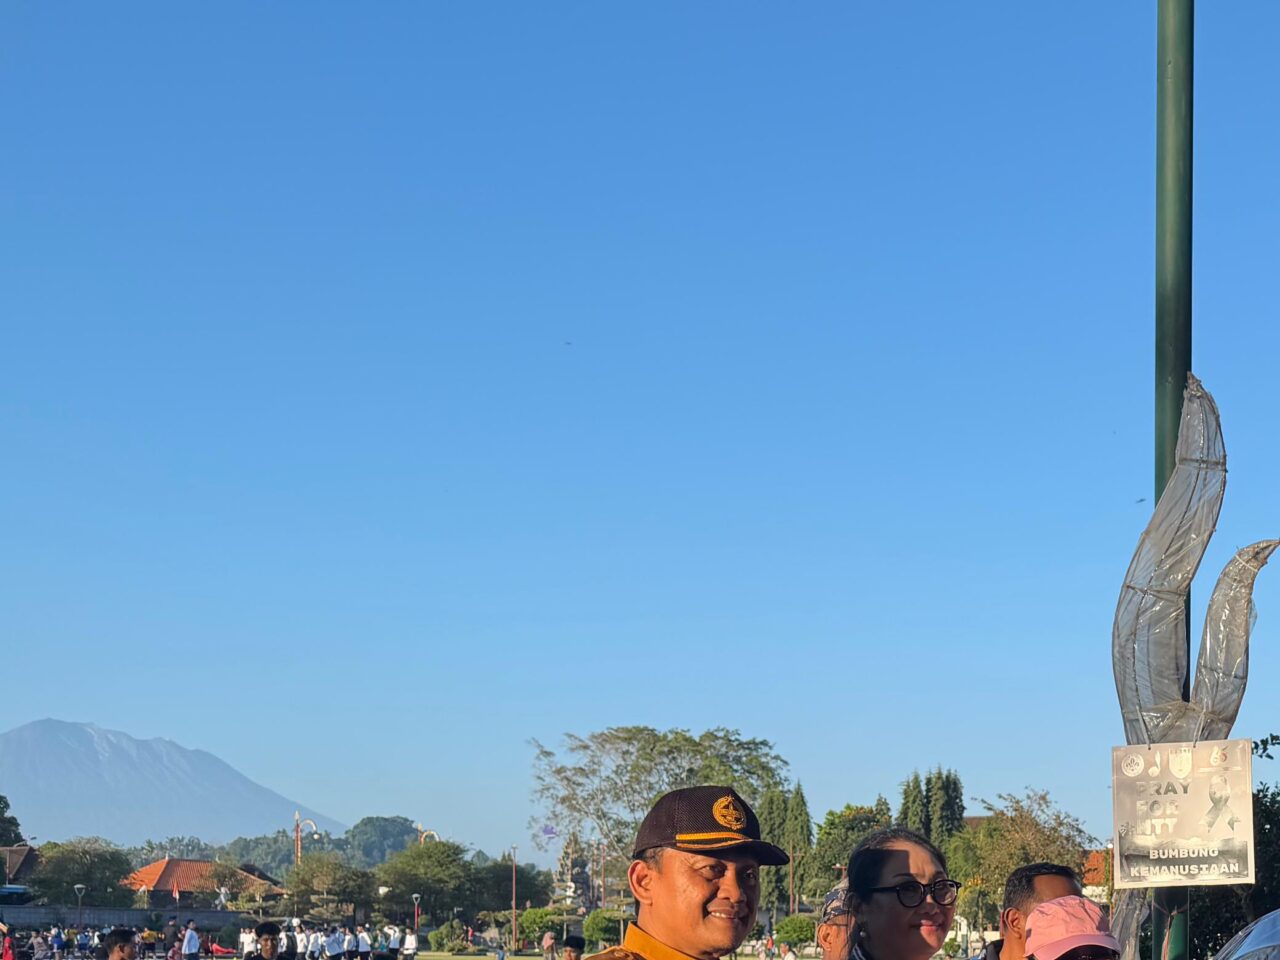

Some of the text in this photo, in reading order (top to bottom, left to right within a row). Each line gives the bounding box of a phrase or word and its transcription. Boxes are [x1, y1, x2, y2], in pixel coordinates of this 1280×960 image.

[1136, 780, 1192, 796] PRAY
[1149, 847, 1219, 860] BUMBUNG
[1130, 863, 1239, 877] KEMANUSIAAN
